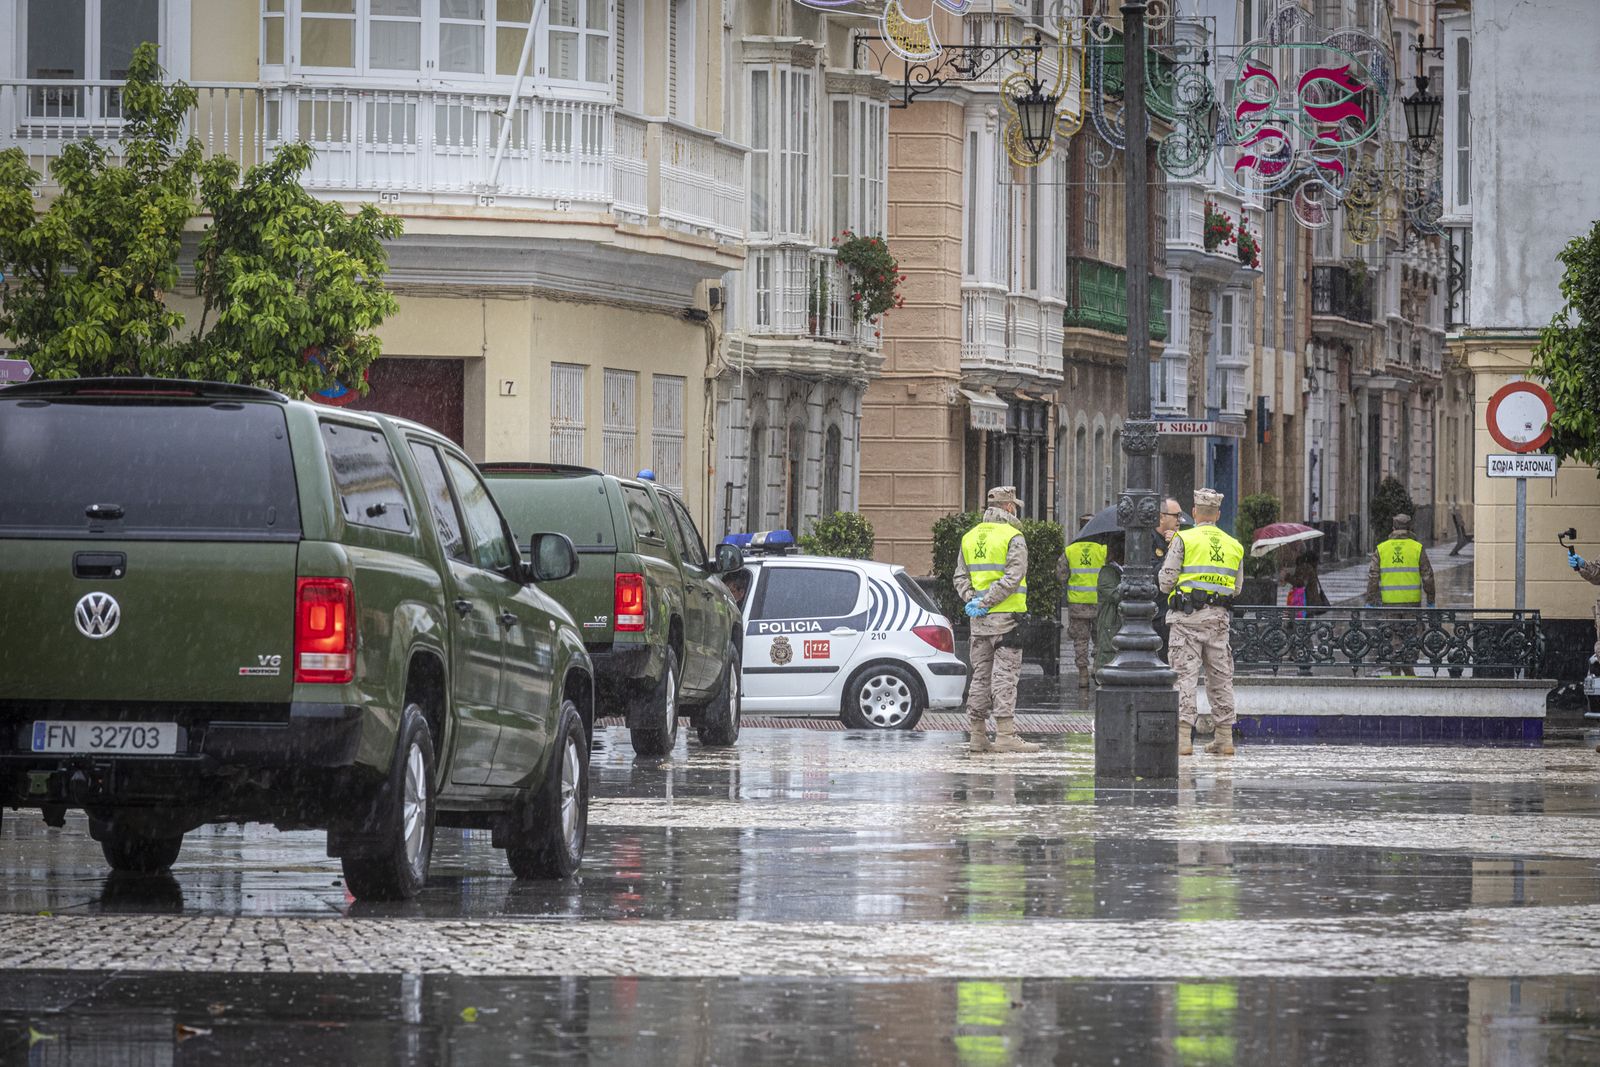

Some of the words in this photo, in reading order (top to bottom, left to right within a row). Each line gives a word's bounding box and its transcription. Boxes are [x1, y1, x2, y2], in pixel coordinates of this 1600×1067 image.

[505, 380, 514, 394] 7
[1170, 422, 1208, 433] SIGLO
[1491, 460, 1514, 472] ZONA
[1515, 460, 1553, 472] PEATONAL
[75, 591, 121, 639] VW
[759, 620, 822, 634] POLICIA
[871, 632, 887, 641] 210
[812, 643, 829, 652] 112
[257, 654, 282, 666] V6
[47, 725, 76, 748] FN
[89, 725, 160, 749] 32703
